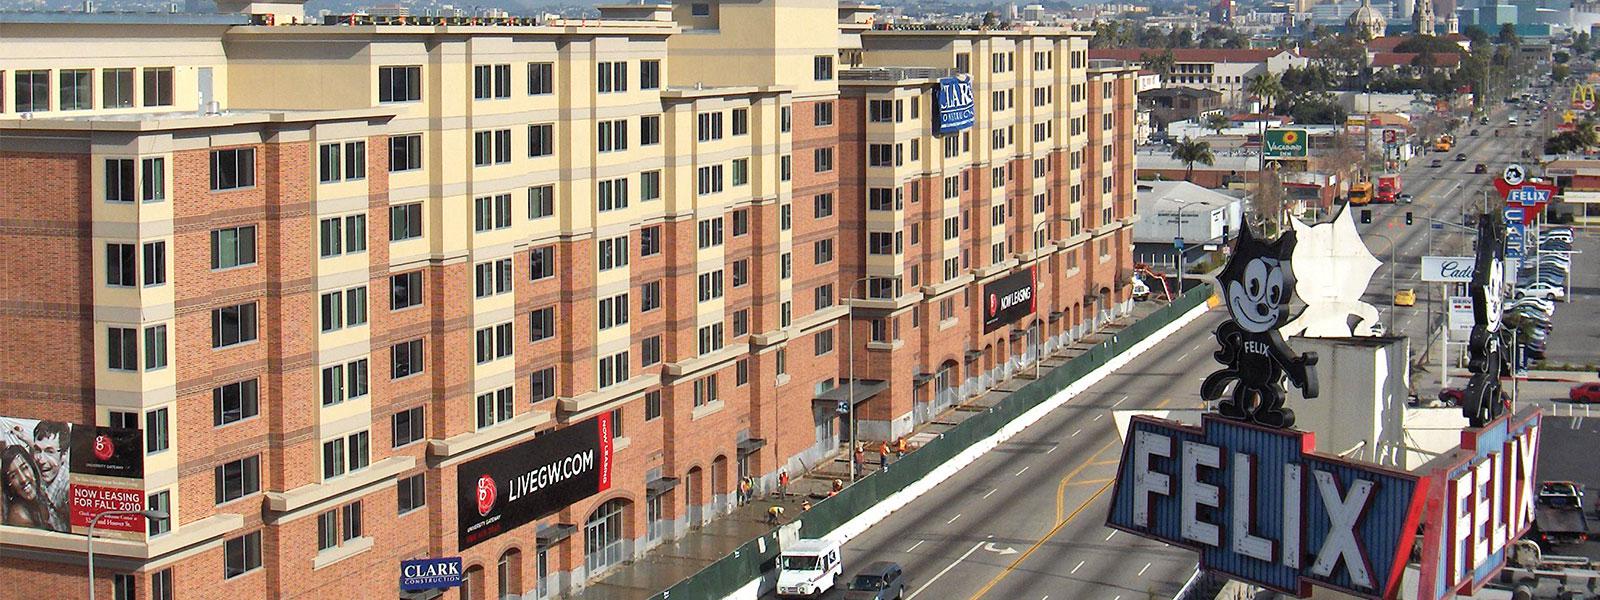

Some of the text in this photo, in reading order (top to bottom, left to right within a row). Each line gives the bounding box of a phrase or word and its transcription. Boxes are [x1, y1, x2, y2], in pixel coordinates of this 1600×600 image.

[1512, 191, 1546, 200] FELIX
[1001, 294, 1012, 310] NOW
[1012, 286, 1031, 305] LEASING
[1244, 341, 1270, 357] FELIX
[508, 449, 594, 502] LIVEGW.COM
[74, 488, 140, 502] NOW LEASING
[74, 497, 141, 511] FOR FALL 2010
[1132, 430, 1378, 589] FELIX
[1449, 425, 1538, 587] FELIX
[404, 562, 459, 578] CLARK
[404, 576, 460, 585] CONSTRUCTION
